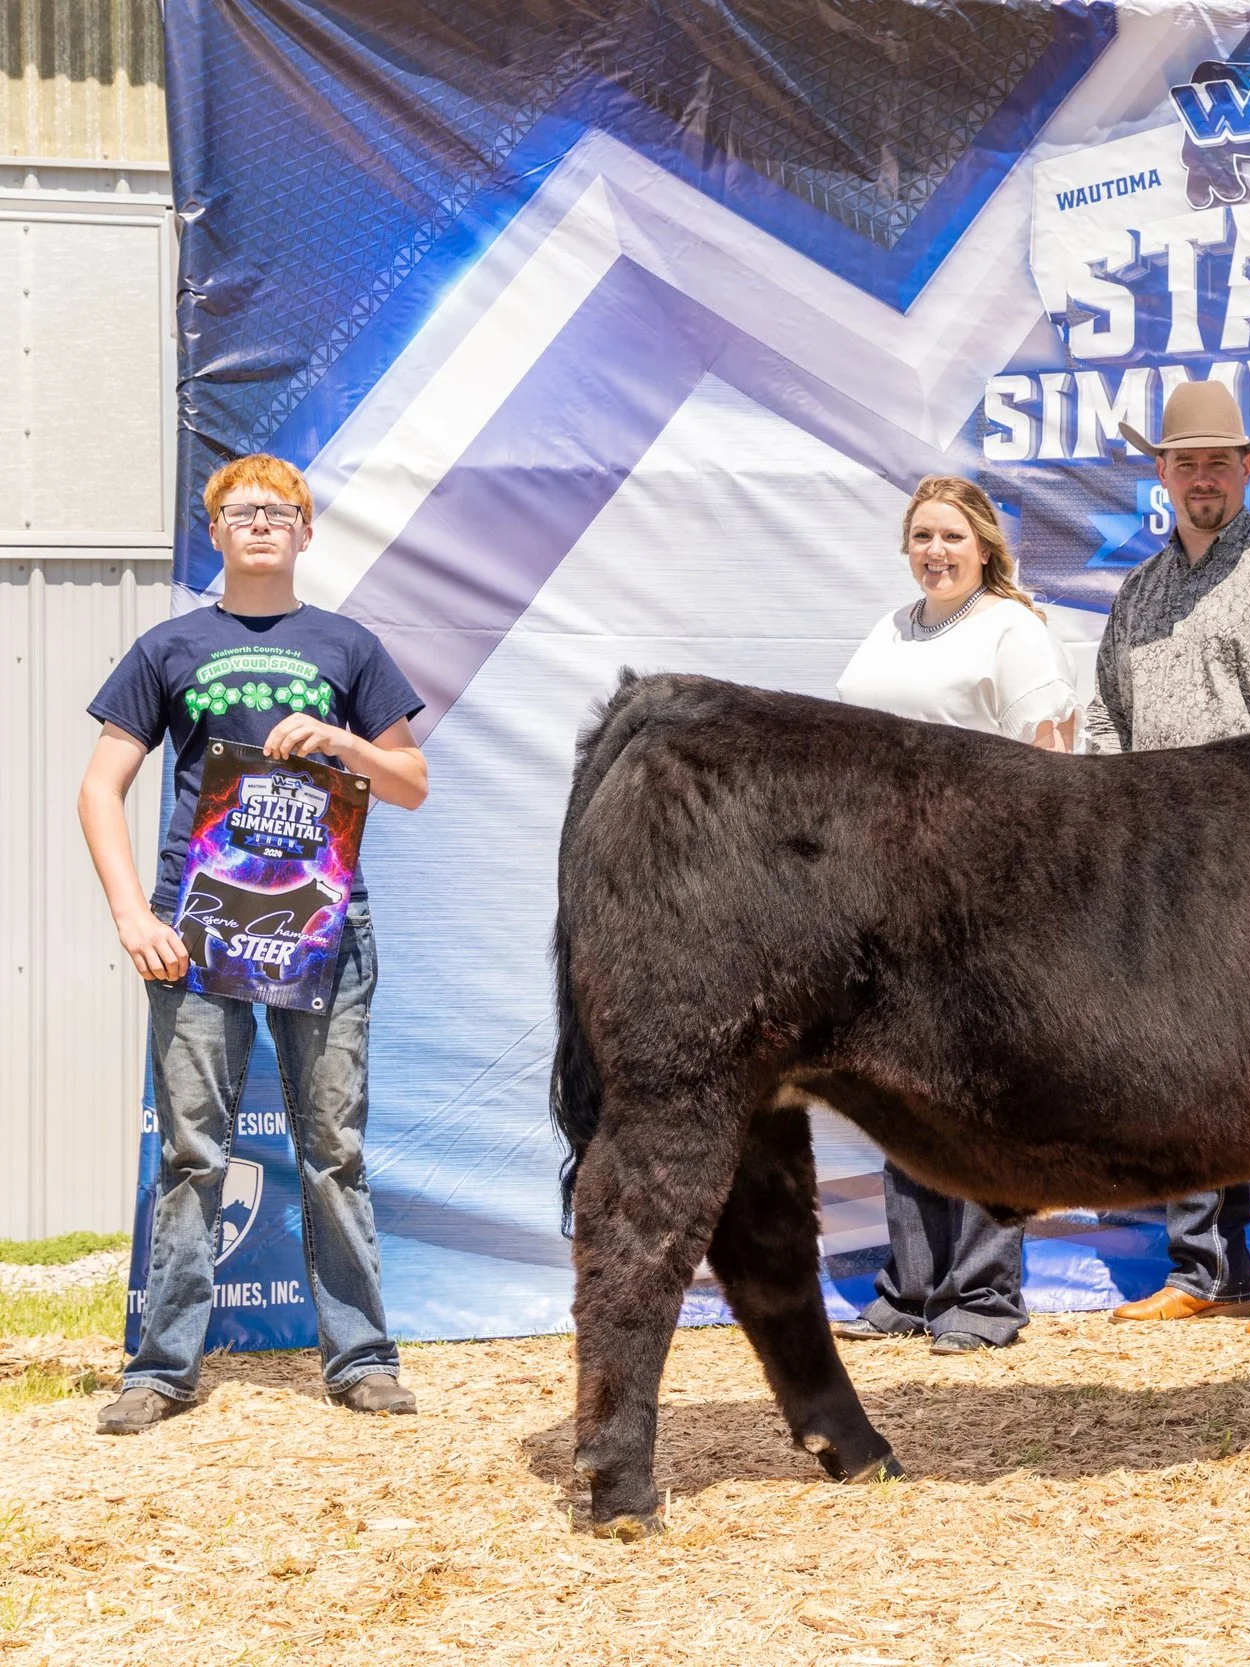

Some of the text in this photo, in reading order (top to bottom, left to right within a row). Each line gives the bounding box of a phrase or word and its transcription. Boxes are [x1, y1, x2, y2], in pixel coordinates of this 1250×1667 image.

[1056, 168, 1162, 211] WAUTOMA
[210, 645, 302, 659] Walworth County 4-H
[199, 658, 315, 681] FIND YOUR SPARK
[248, 795, 315, 825] STATE
[231, 811, 323, 842] SIMMENTAL
[255, 833, 296, 848] SHOW
[174, 891, 329, 947] Reserve Champion
[226, 933, 297, 966] STEER
[238, 1112, 286, 1136] ESIGN
[128, 1280, 305, 1314] TH TIMES, INC.
